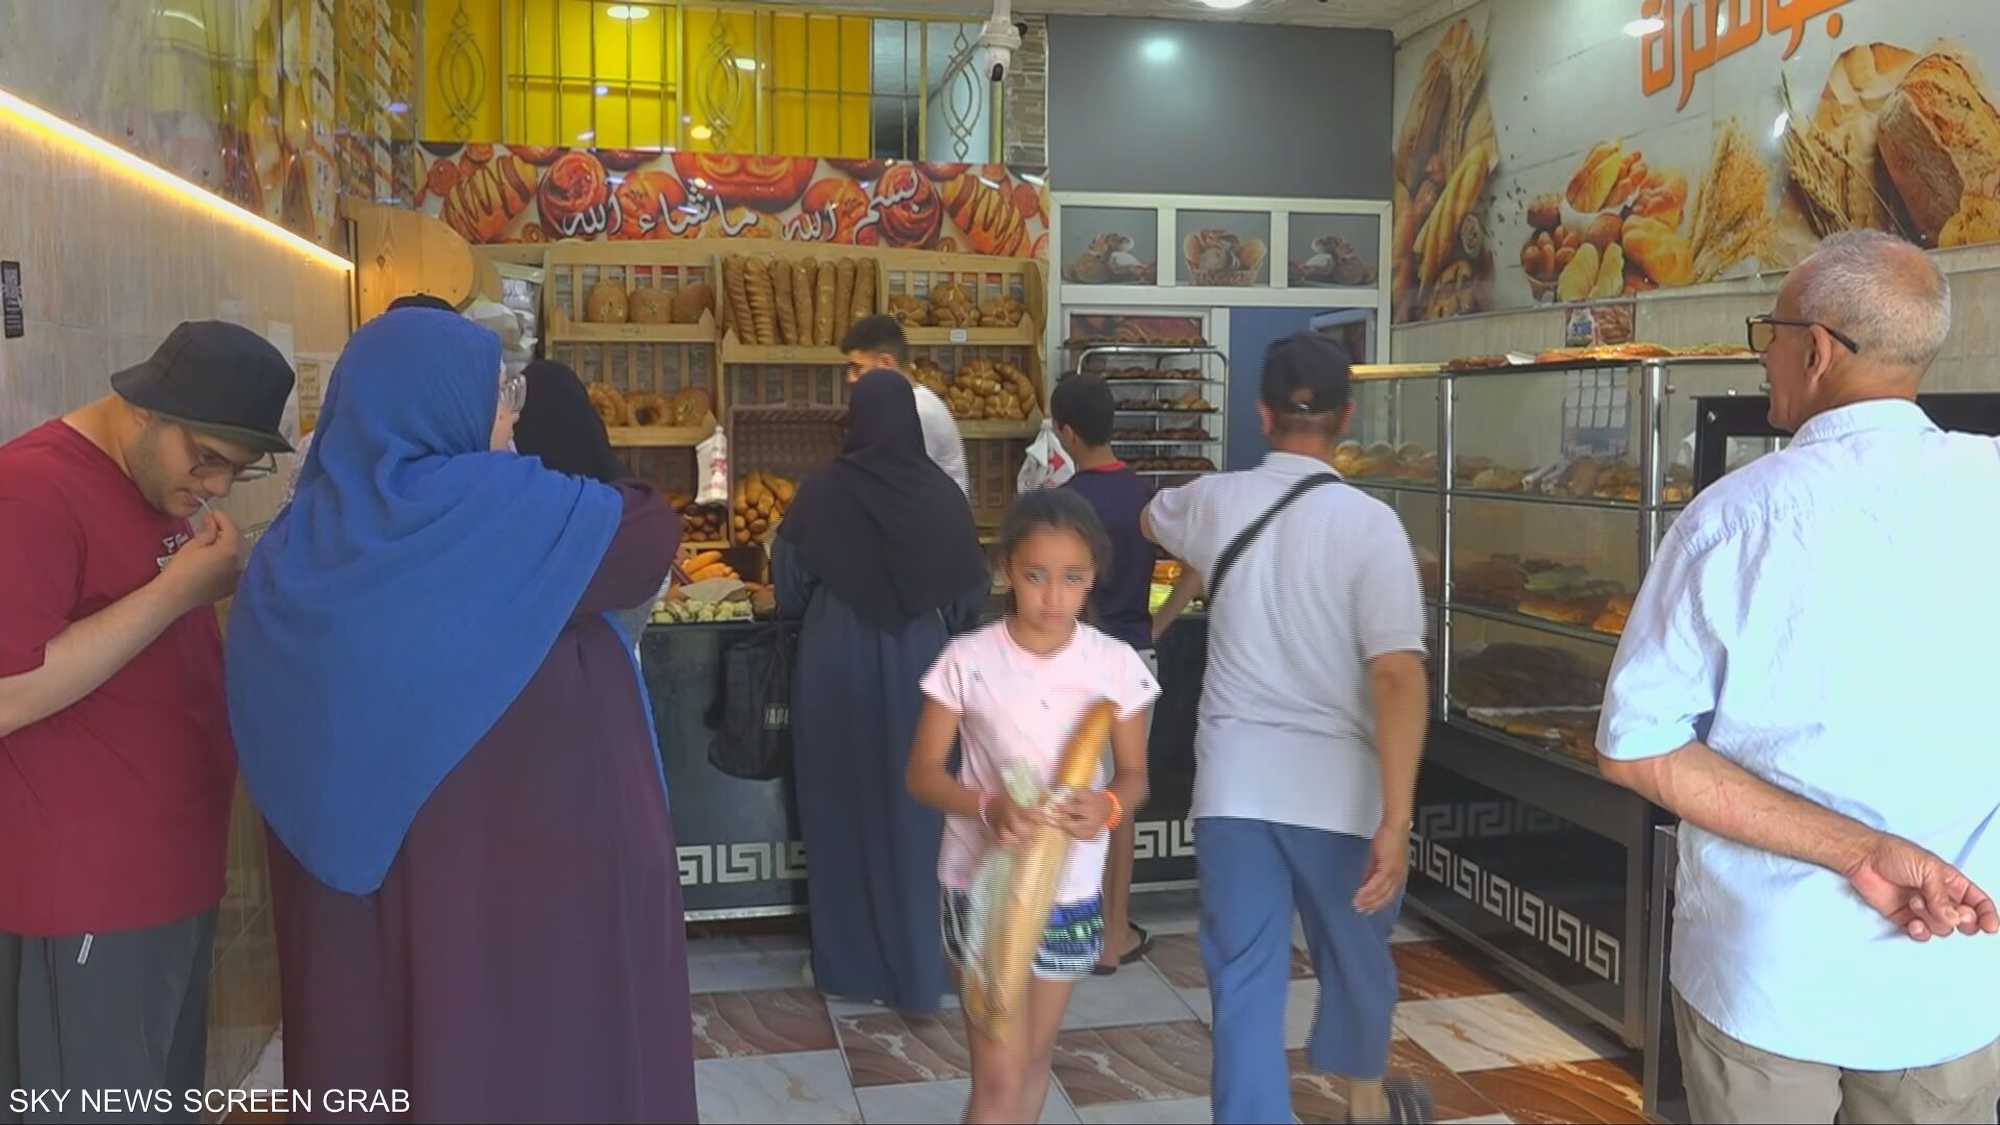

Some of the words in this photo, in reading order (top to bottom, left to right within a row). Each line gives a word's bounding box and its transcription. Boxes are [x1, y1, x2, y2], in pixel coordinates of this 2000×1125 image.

[561, 190, 622, 238] الله
[781, 200, 837, 241] الله
[852, 165, 919, 246] بسم
